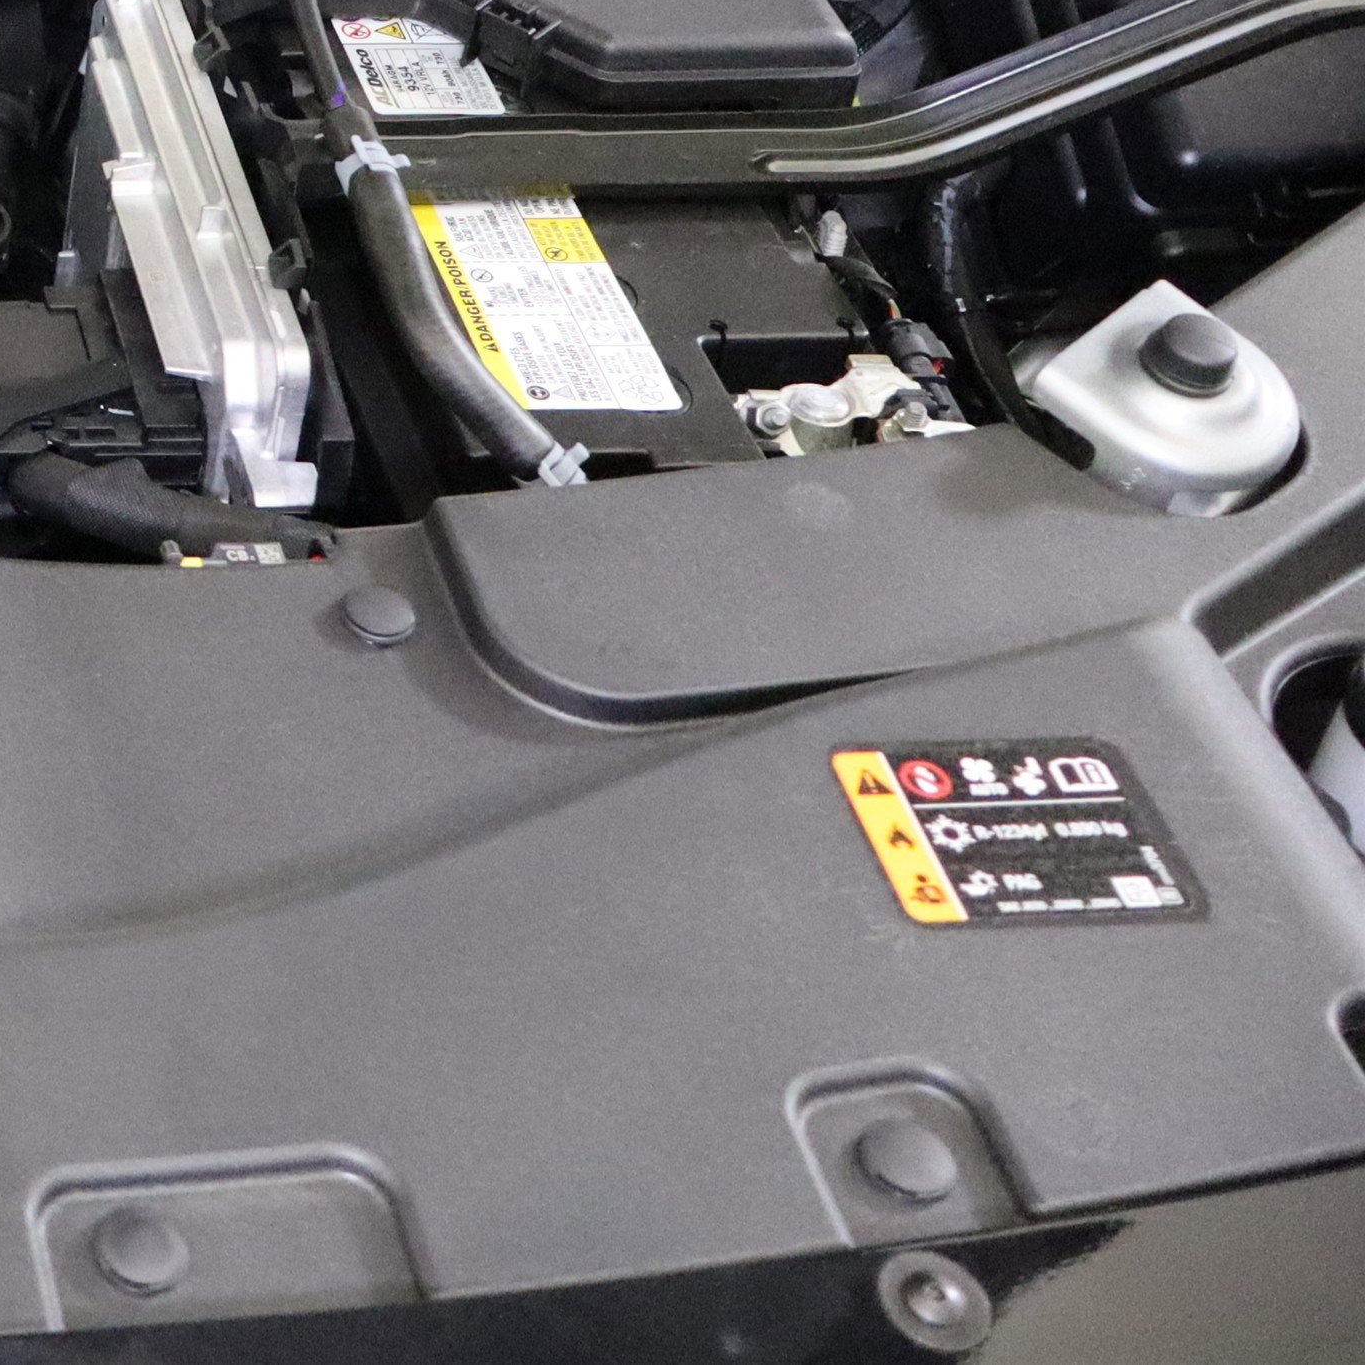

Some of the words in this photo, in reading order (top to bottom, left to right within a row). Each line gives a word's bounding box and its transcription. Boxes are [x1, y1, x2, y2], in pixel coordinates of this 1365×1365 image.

[356, 49, 392, 106] ACDelco
[398, 65, 420, 91] 9354
[434, 240, 494, 344] DANGER/POISON
